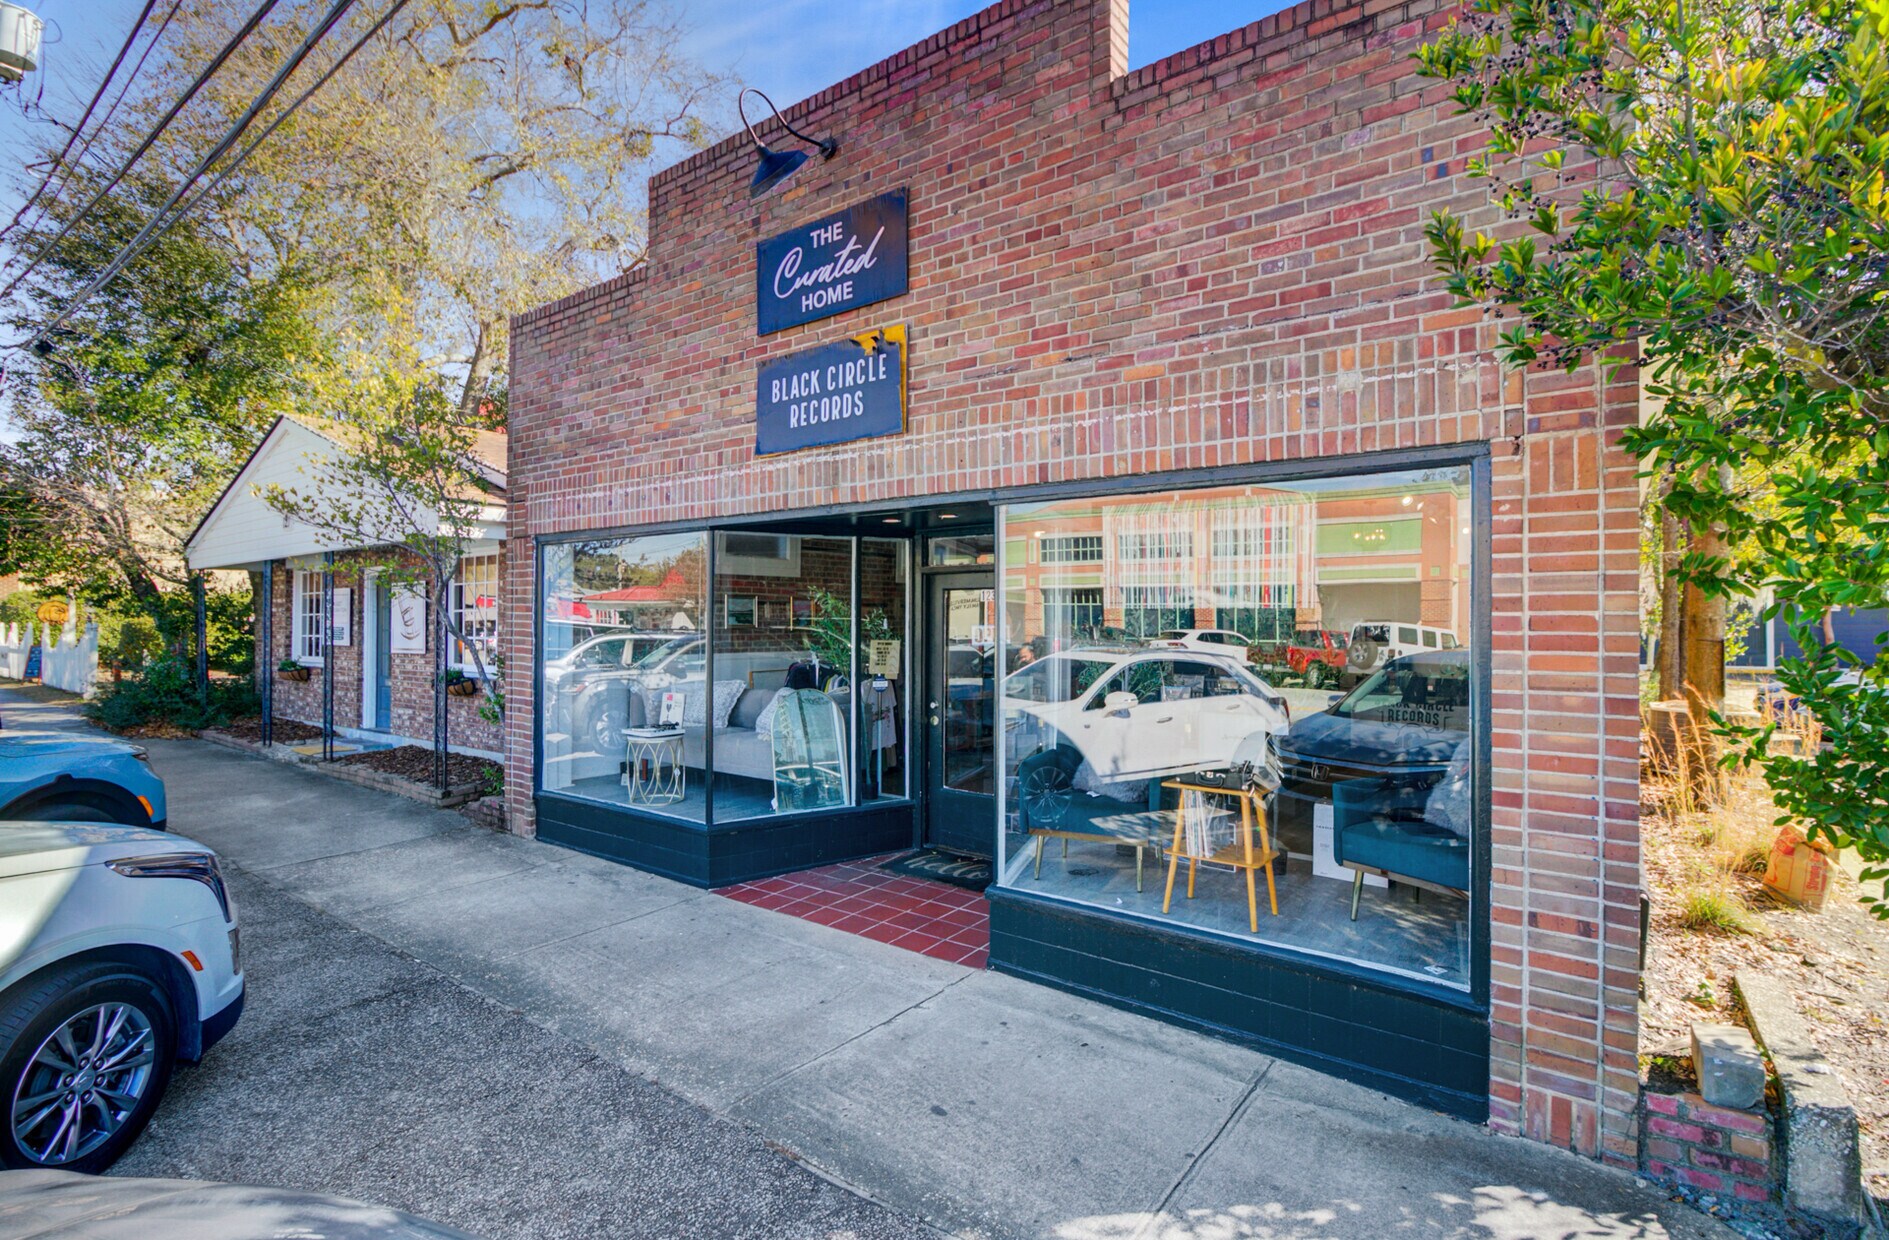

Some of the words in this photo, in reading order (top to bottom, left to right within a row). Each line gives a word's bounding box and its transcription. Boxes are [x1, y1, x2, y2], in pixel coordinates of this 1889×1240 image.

[810, 221, 843, 249] THE
[774, 225, 885, 299] Curated
[801, 281, 853, 312] HOME
[772, 369, 820, 404] BLACK
[827, 354, 887, 391] CIRCLE
[790, 390, 864, 429] RECORDS
[1387, 708, 1440, 726] RECORDS
[904, 854, 989, 879] hello
